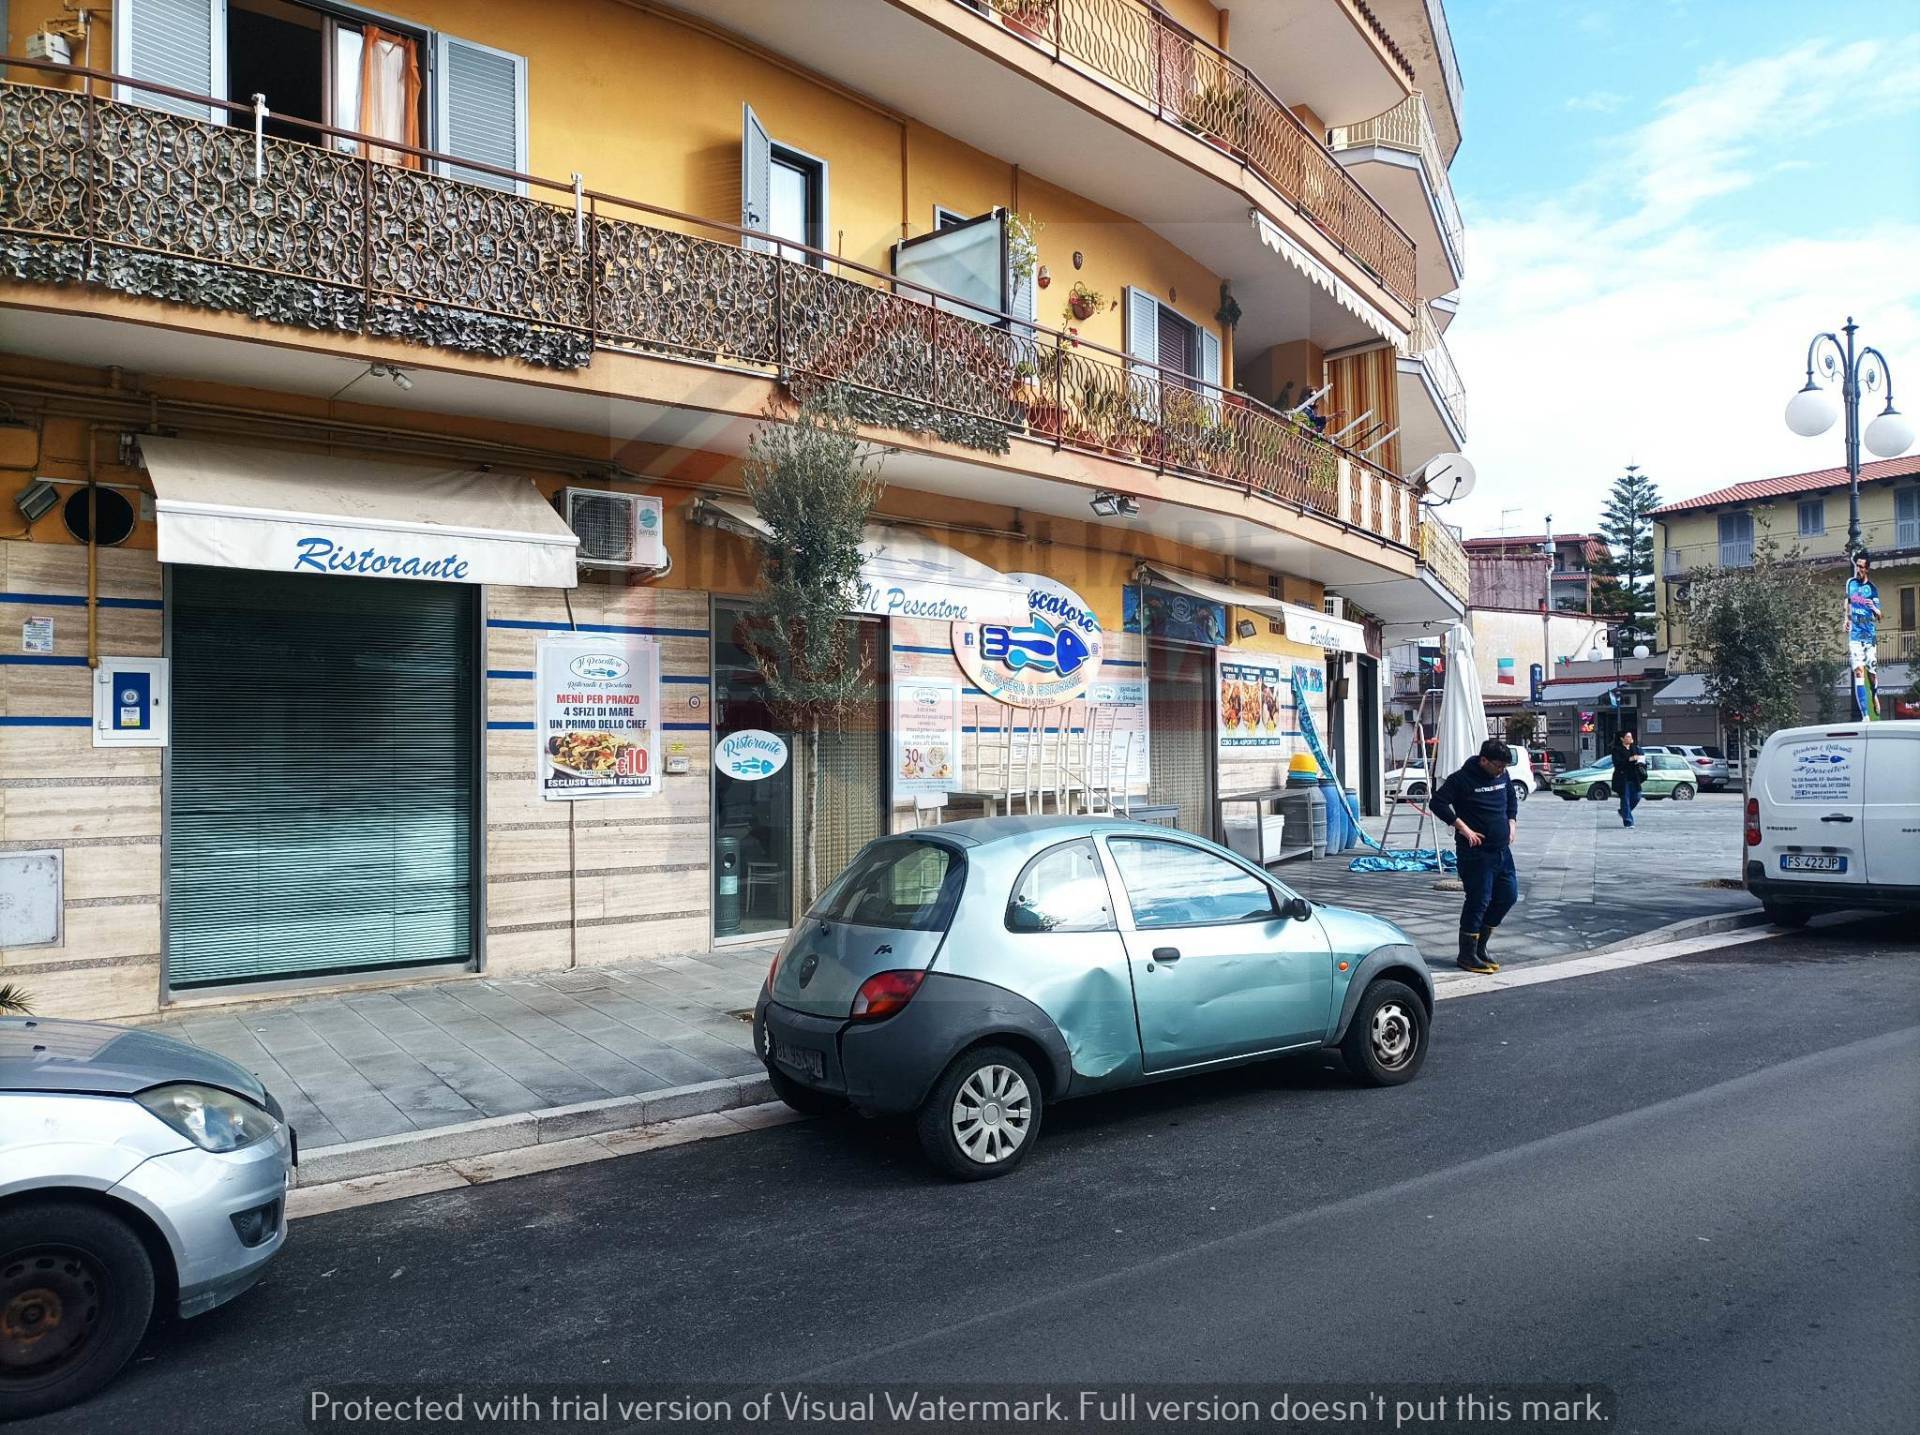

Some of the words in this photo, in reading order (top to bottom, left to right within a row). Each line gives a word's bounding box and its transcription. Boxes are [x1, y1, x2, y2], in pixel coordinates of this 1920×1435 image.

[294, 537, 469, 579] Ristorante
[862, 583, 880, 612] Il
[887, 587, 968, 620] Pescatore
[1028, 589, 1093, 632] scatore
[556, 691, 584, 704] MENÙ
[586, 694, 604, 704] PER
[606, 695, 640, 704] PRANZO
[563, 707, 570, 716] 4
[572, 707, 595, 716] SFIZI
[597, 707, 606, 716] DI
[608, 707, 634, 717] MARE
[549, 719, 564, 729] UN
[566, 720, 595, 729] PRIMO
[598, 720, 624, 729] DELLO
[626, 720, 647, 729] CHEF
[724, 734, 782, 757] Ristorante
[548, 779, 586, 788] ESCLUSO
[588, 778, 617, 787] GIORNI
[619, 778, 650, 786] FESTIVI
[1788, 856, 1801, 867] FS
[1804, 857, 1838, 869] 422JP
